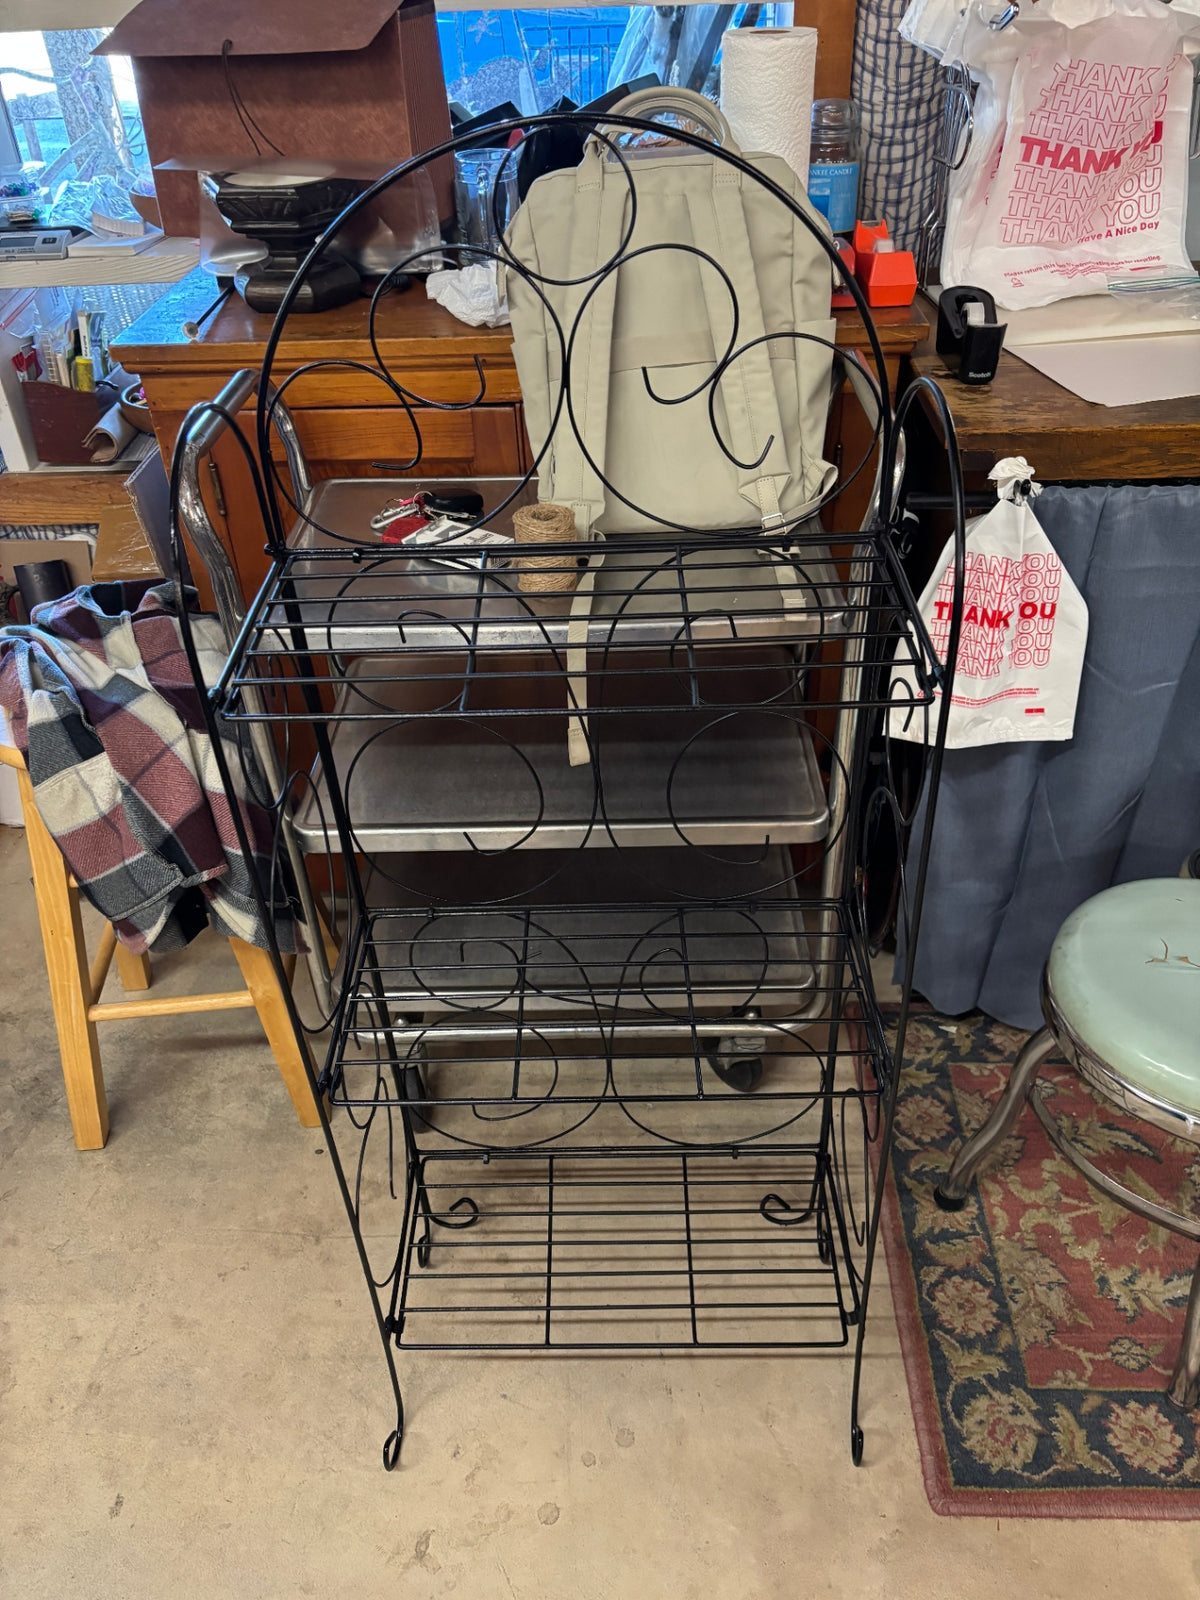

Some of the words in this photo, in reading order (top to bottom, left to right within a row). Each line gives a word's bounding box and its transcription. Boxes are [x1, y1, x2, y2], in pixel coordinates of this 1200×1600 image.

[1029, 111, 1140, 149] THANK
[1020, 136, 1130, 174] THANK
[1000, 211, 1094, 244] THANK
[1100, 192, 1161, 227] YOU
[1105, 229, 1113, 239] A
[1115, 226, 1138, 238] Nice
[1140, 221, 1160, 233] Day
